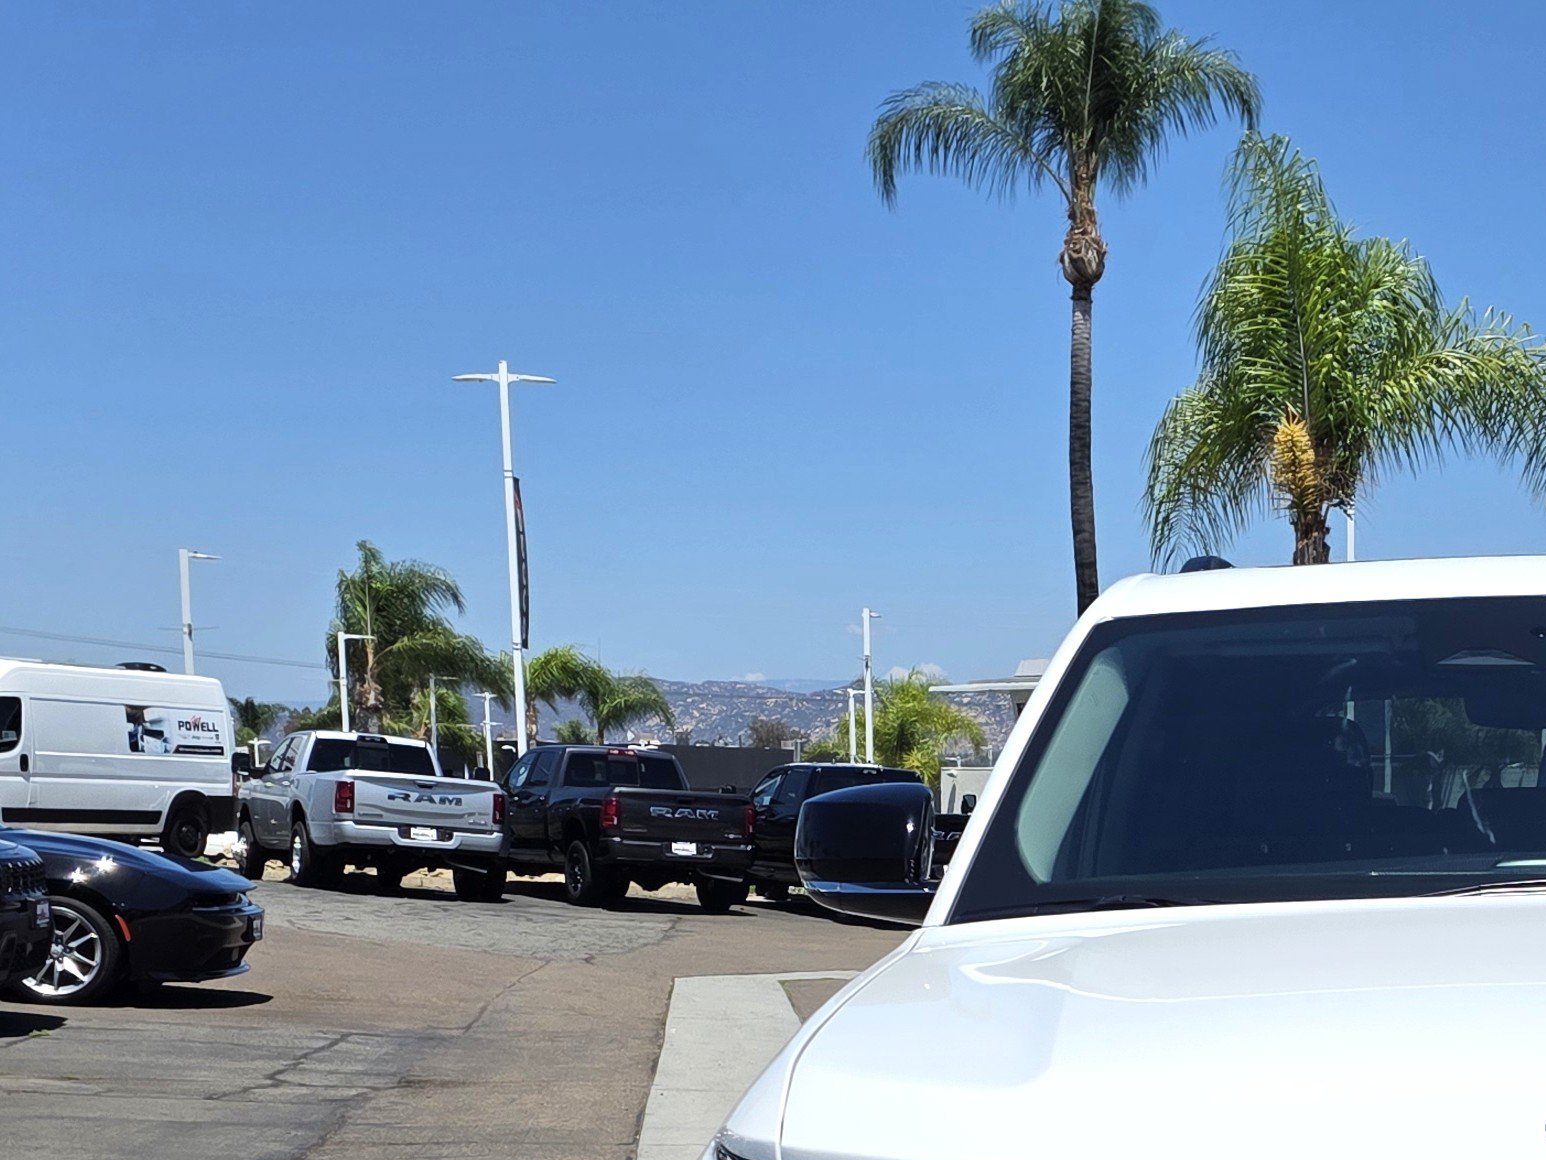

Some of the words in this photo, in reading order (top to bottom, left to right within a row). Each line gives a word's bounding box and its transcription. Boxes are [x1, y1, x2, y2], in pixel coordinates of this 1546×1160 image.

[177, 720, 219, 732] POWELL
[387, 792, 463, 807] RAM
[650, 806, 719, 821] RAM
